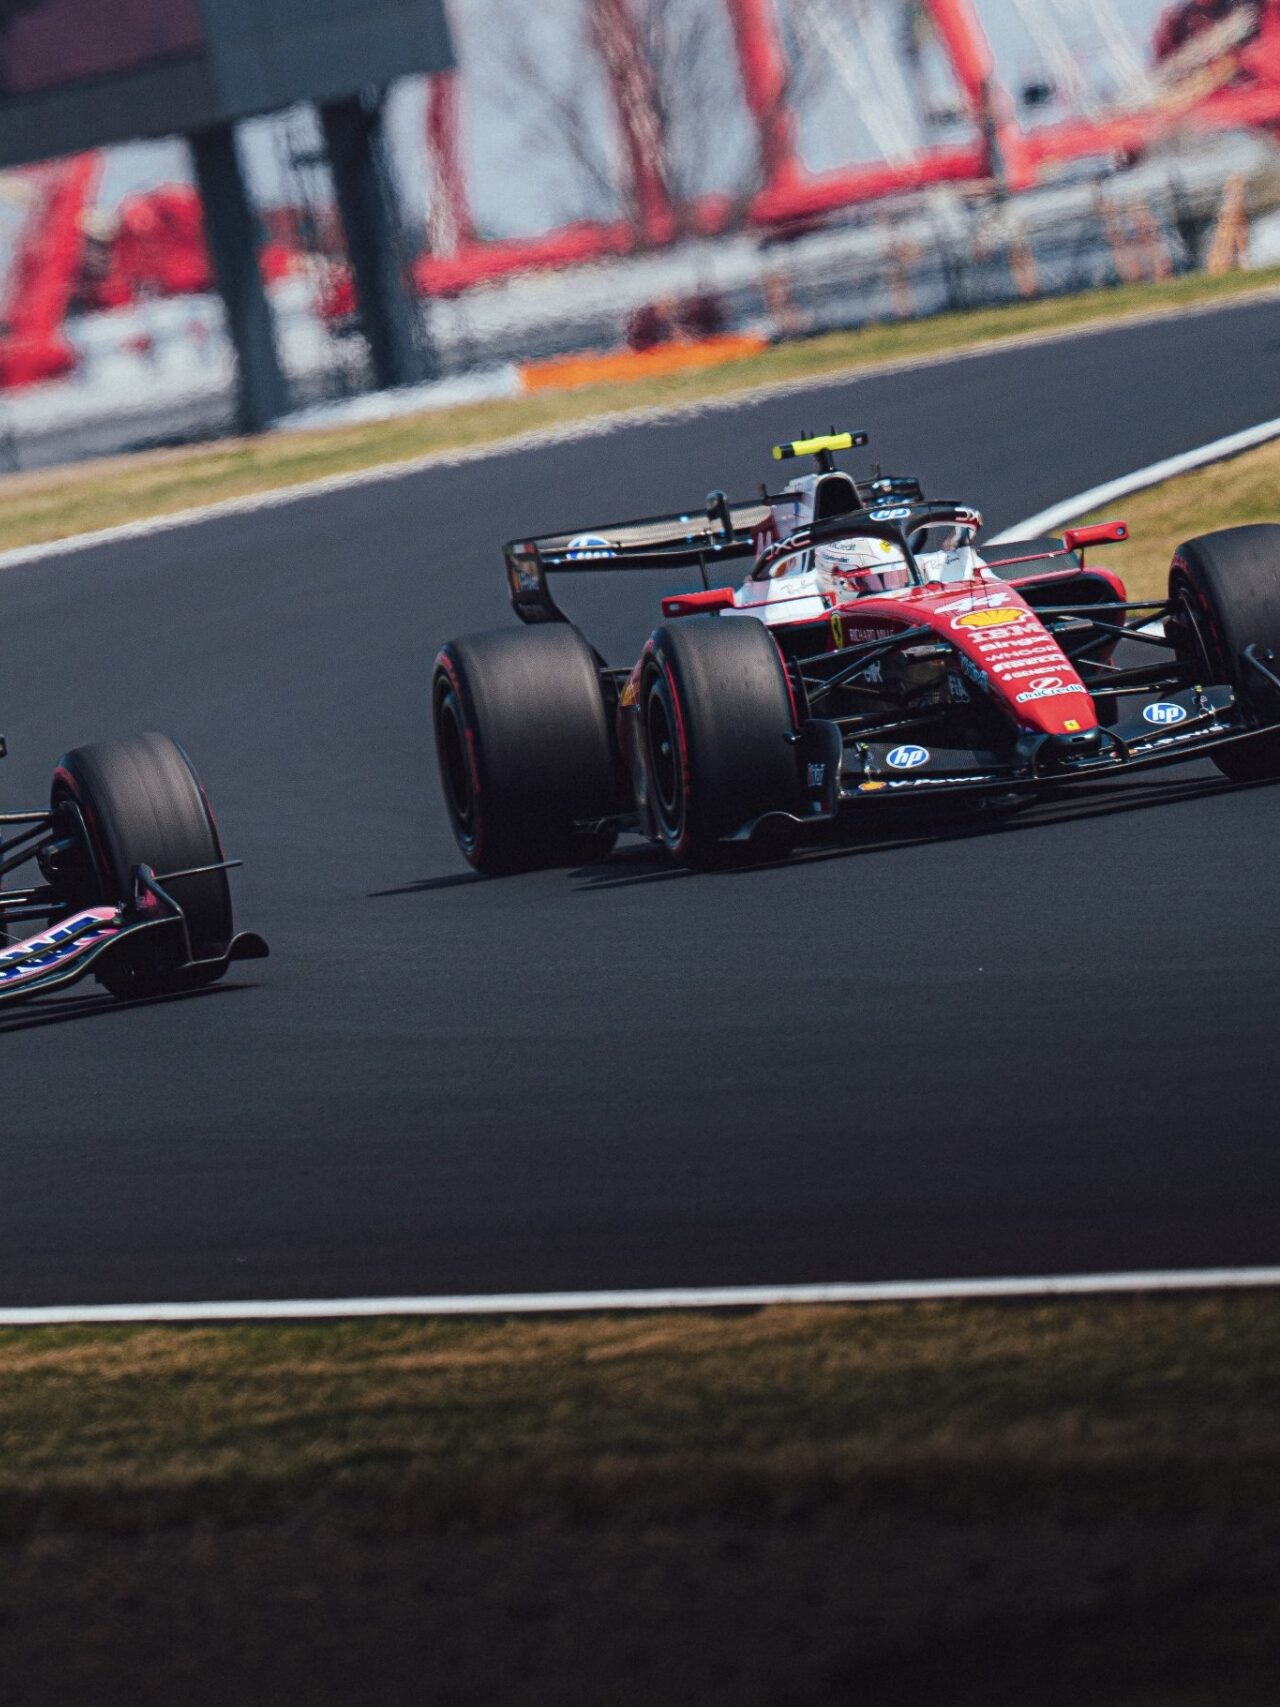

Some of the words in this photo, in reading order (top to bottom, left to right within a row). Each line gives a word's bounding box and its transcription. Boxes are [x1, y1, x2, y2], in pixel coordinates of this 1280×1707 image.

[968, 623, 1045, 643] IBM
[1152, 704, 1179, 723] hp
[893, 746, 922, 768] hp
